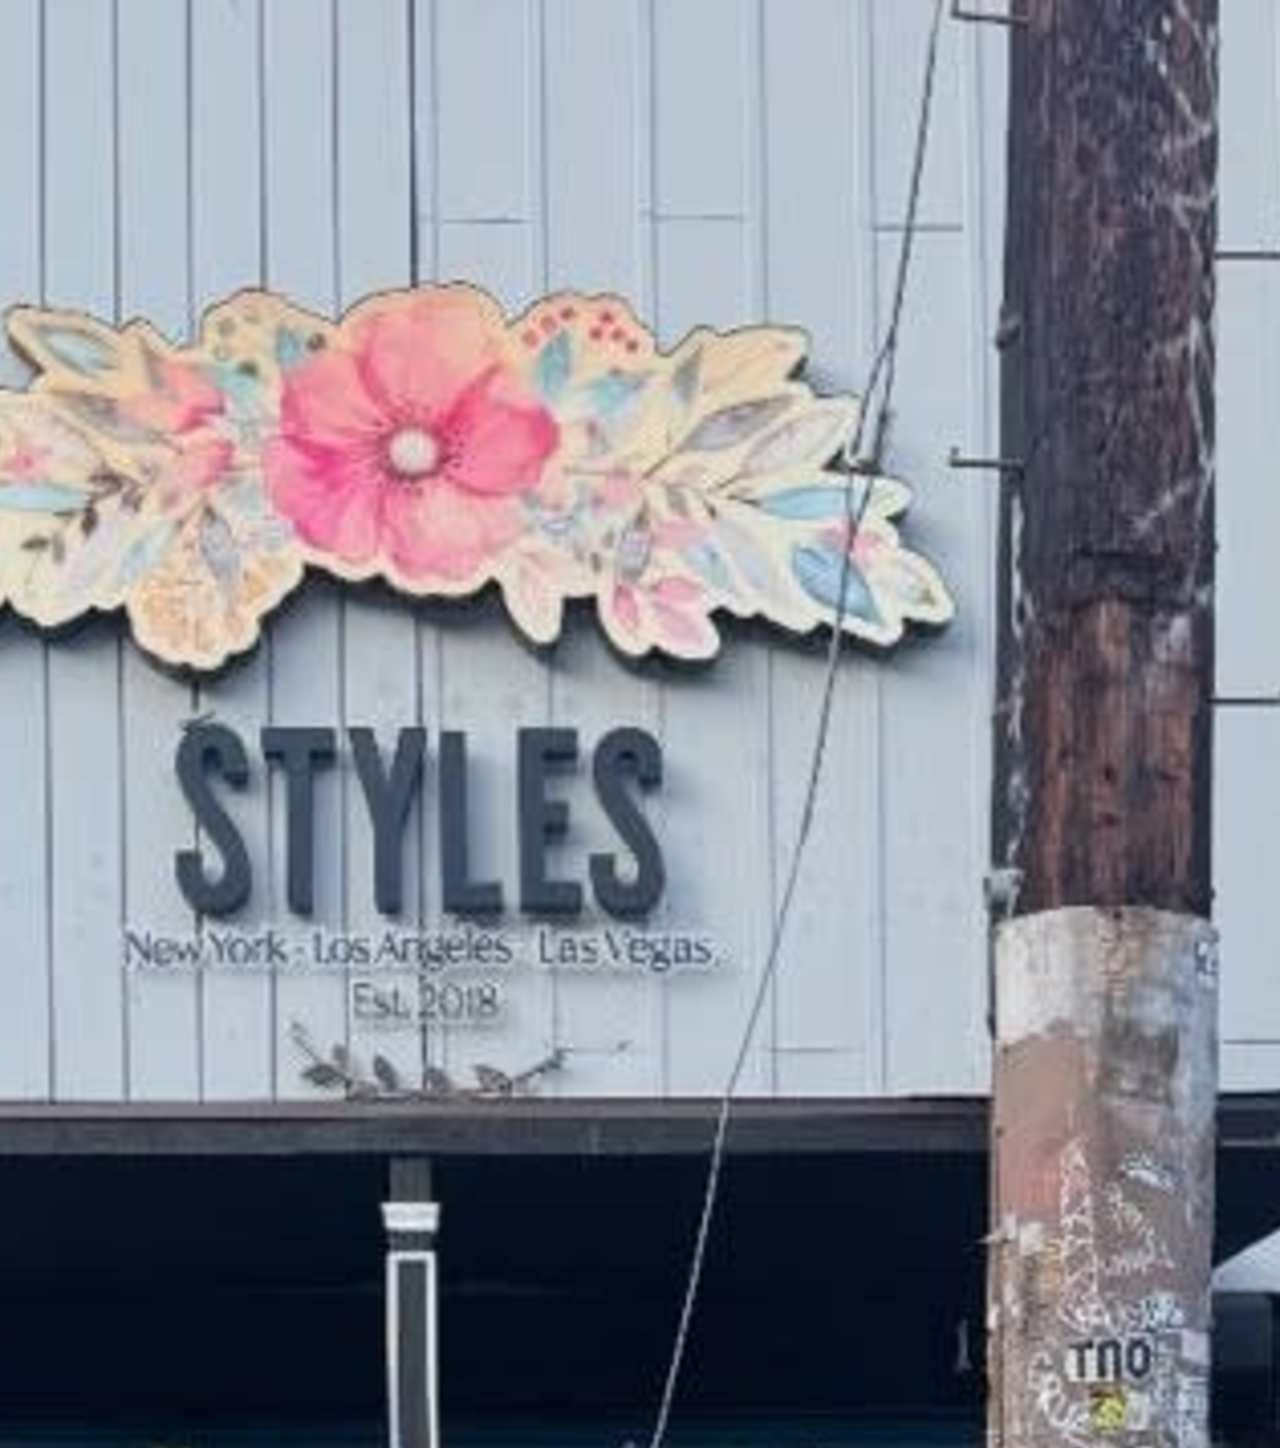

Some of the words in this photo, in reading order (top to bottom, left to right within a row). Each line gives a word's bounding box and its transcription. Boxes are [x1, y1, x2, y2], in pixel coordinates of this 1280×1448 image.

[173, 722, 670, 920] STYLES
[124, 930, 203, 965] New
[208, 930, 288, 964] York
[313, 932, 370, 965] Los
[375, 930, 514, 972] Angeles
[538, 930, 598, 964] Las
[419, 982, 500, 1019] 2018
